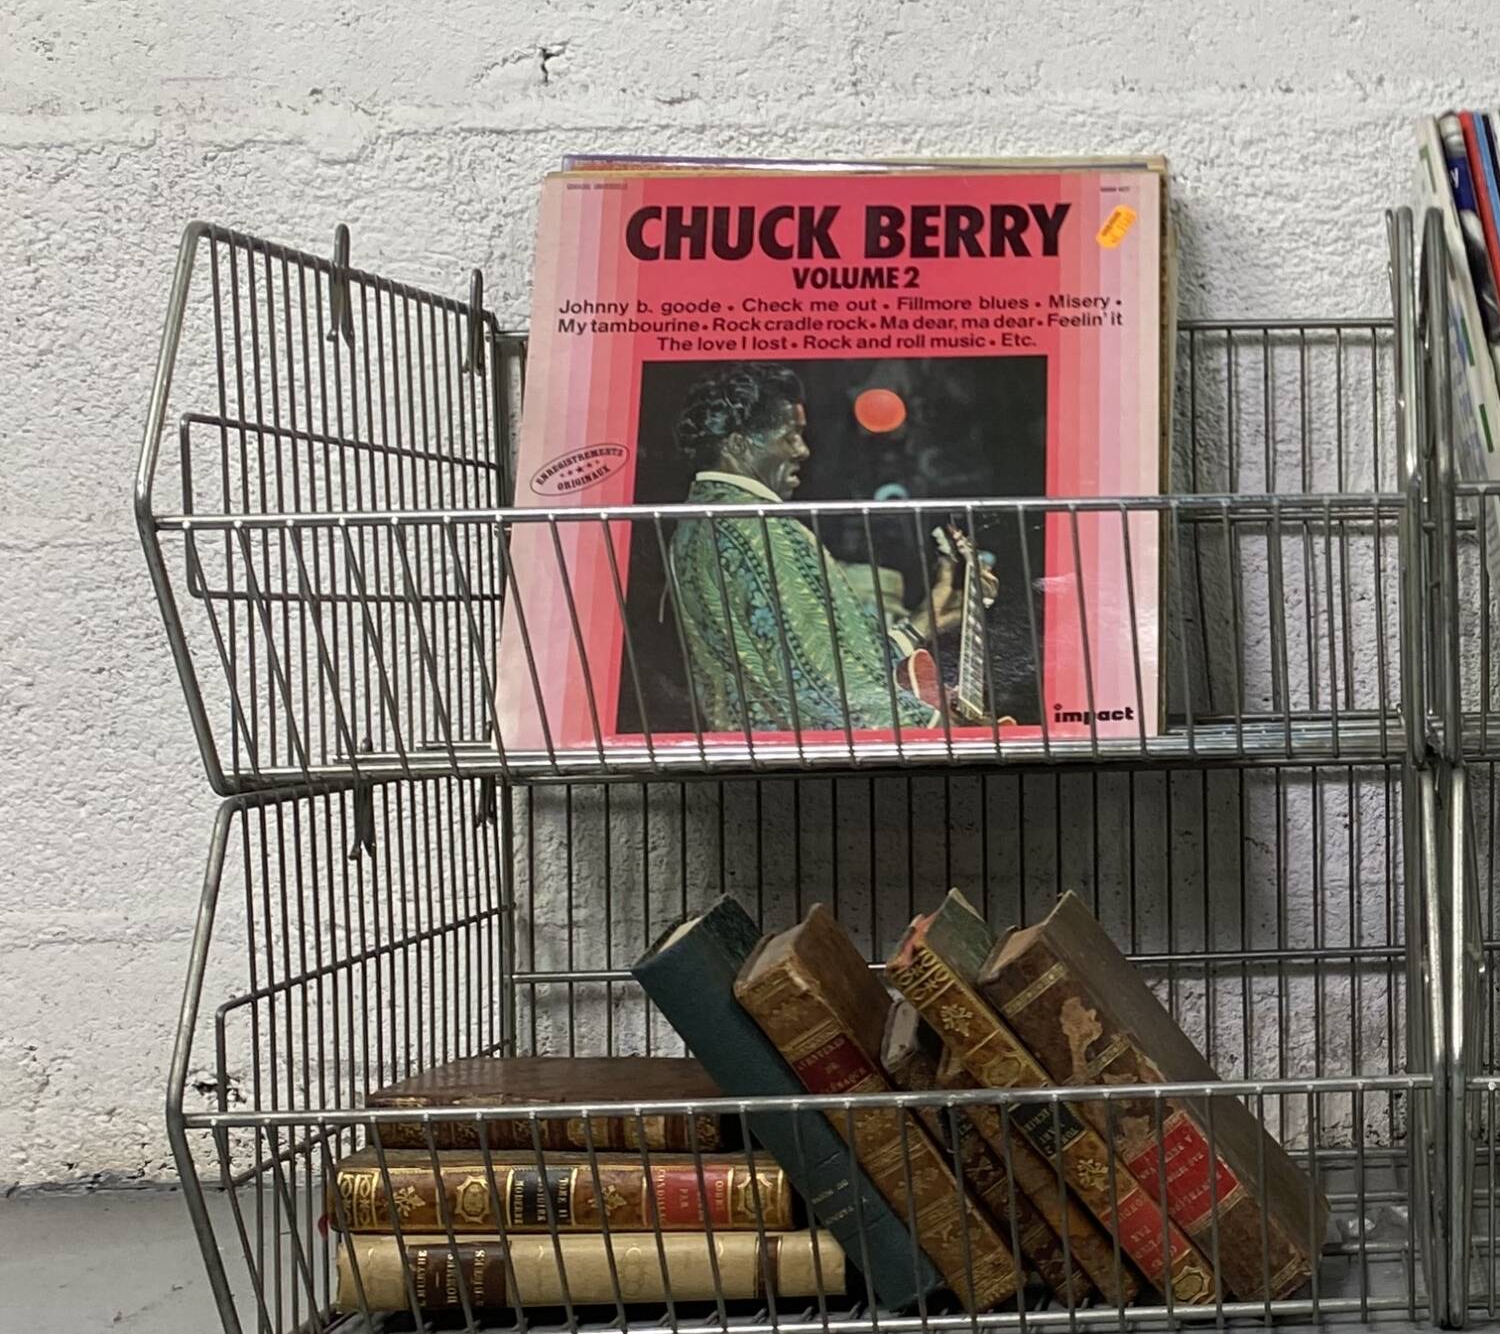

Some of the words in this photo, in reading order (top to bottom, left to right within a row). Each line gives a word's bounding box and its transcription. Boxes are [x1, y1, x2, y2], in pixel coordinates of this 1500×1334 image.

[626, 205, 841, 261] CHUCK
[864, 203, 1072, 259] BERRY
[792, 267, 899, 289] VOLUME
[903, 267, 920, 289] 2
[558, 299, 629, 317] Johnny
[636, 299, 653, 313] b.
[660, 299, 722, 316] goode
[742, 298, 803, 313] Check
[810, 301, 840, 313] me
[846, 298, 877, 312] out
[896, 296, 972, 311] Fillmore
[978, 296, 1029, 310] blues
[1049, 294, 1111, 311] Misery
[557, 319, 587, 335] My
[590, 318, 699, 334] tambourine
[712, 317, 761, 332] Rock
[765, 317, 823, 332] cradle
[827, 316, 869, 331] rock
[880, 316, 910, 330] Ma
[919, 316, 958, 331] dear,
[962, 318, 989, 329] ma
[996, 315, 1035, 329] dear
[1047, 313, 1108, 328] Feelin'
[1110, 313, 1123, 326] it
[657, 337, 693, 351] The
[698, 337, 737, 351] love
[752, 337, 788, 350] lost
[803, 336, 852, 349] Rock
[856, 335, 891, 349] and
[896, 334, 926, 348] roll
[930, 334, 986, 348] music
[1001, 333, 1037, 348] Etc.
